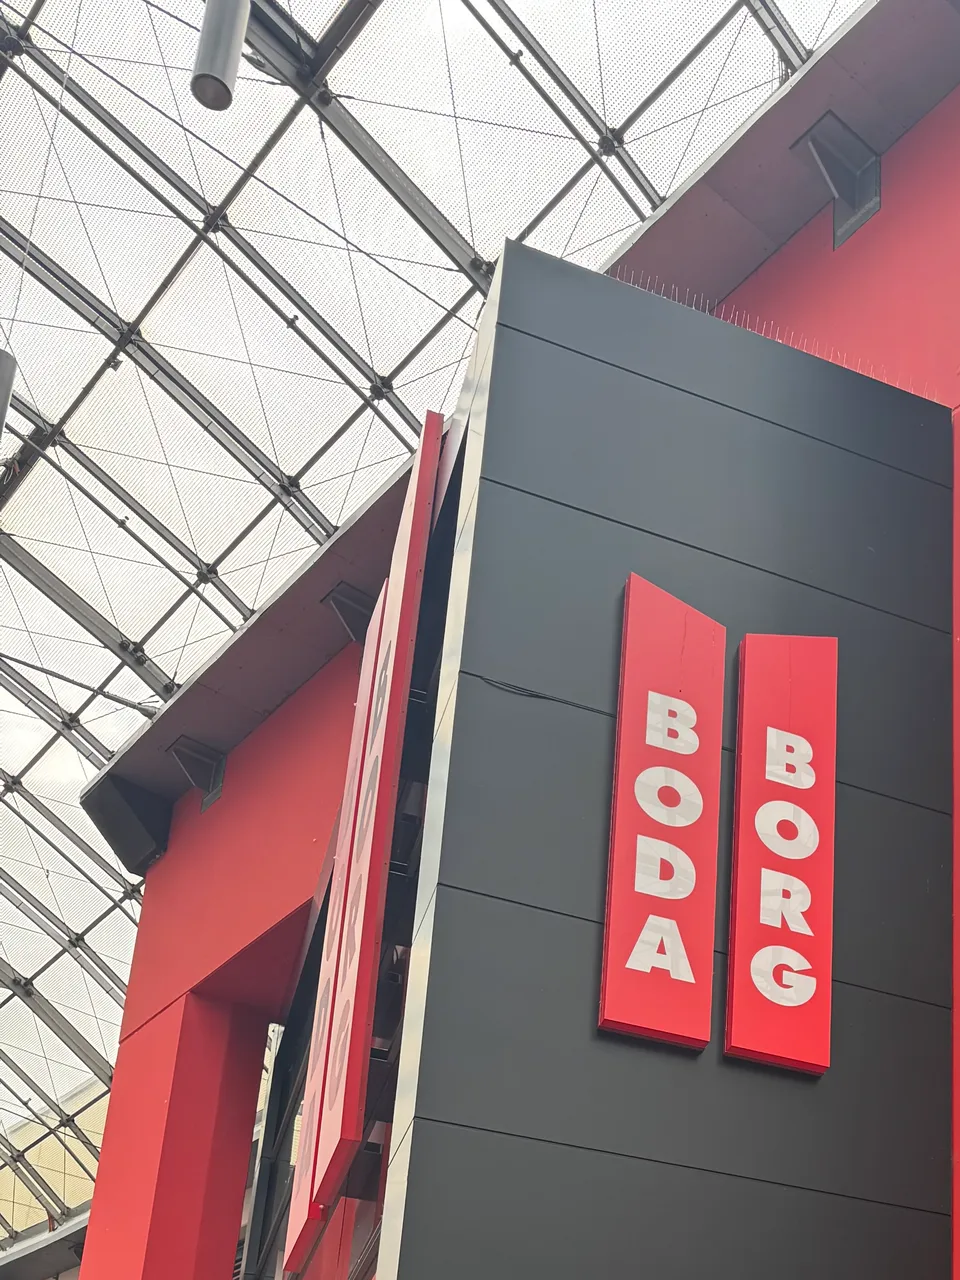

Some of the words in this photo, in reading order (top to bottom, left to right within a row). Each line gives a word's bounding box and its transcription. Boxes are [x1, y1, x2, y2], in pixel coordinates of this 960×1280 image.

[329, 640, 392, 1111] BORG
[625, 690, 703, 984] BODA
[750, 726, 820, 1008] BORG
